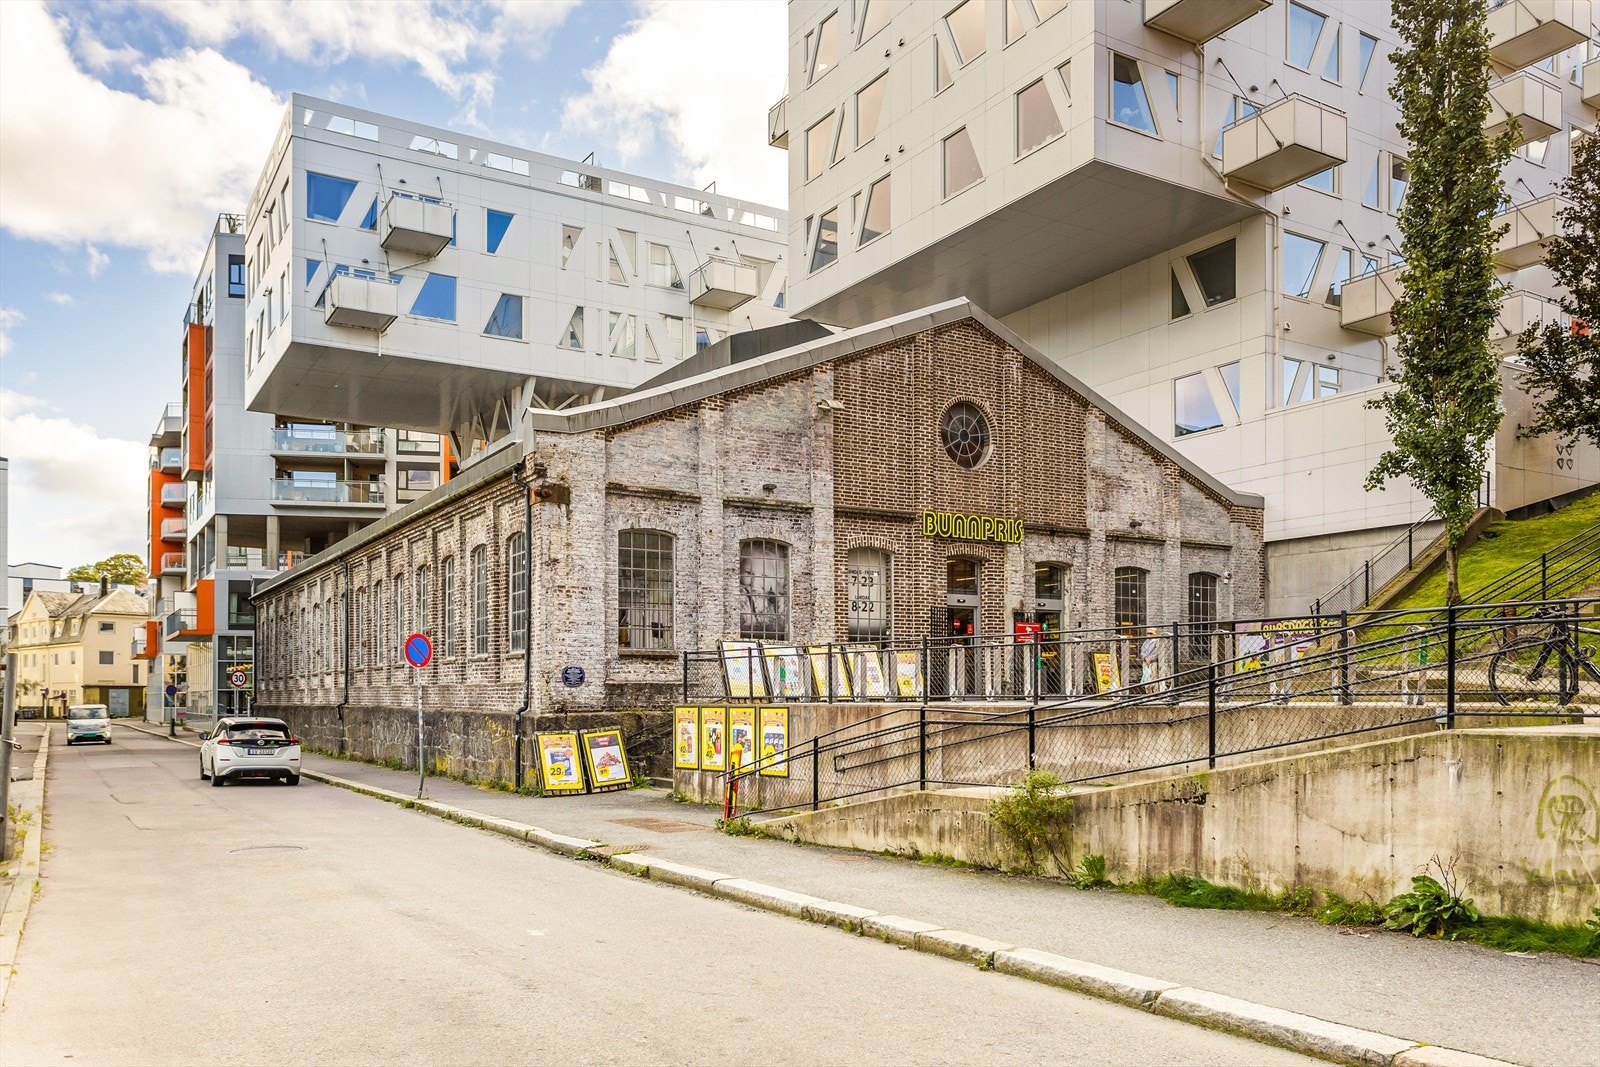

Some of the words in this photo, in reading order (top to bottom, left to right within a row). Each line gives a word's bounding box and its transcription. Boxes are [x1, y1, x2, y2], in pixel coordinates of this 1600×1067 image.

[923, 511, 1024, 543] BUNNPRIS
[851, 601, 875, 612] 8-22
[233, 674, 244, 683] 30
